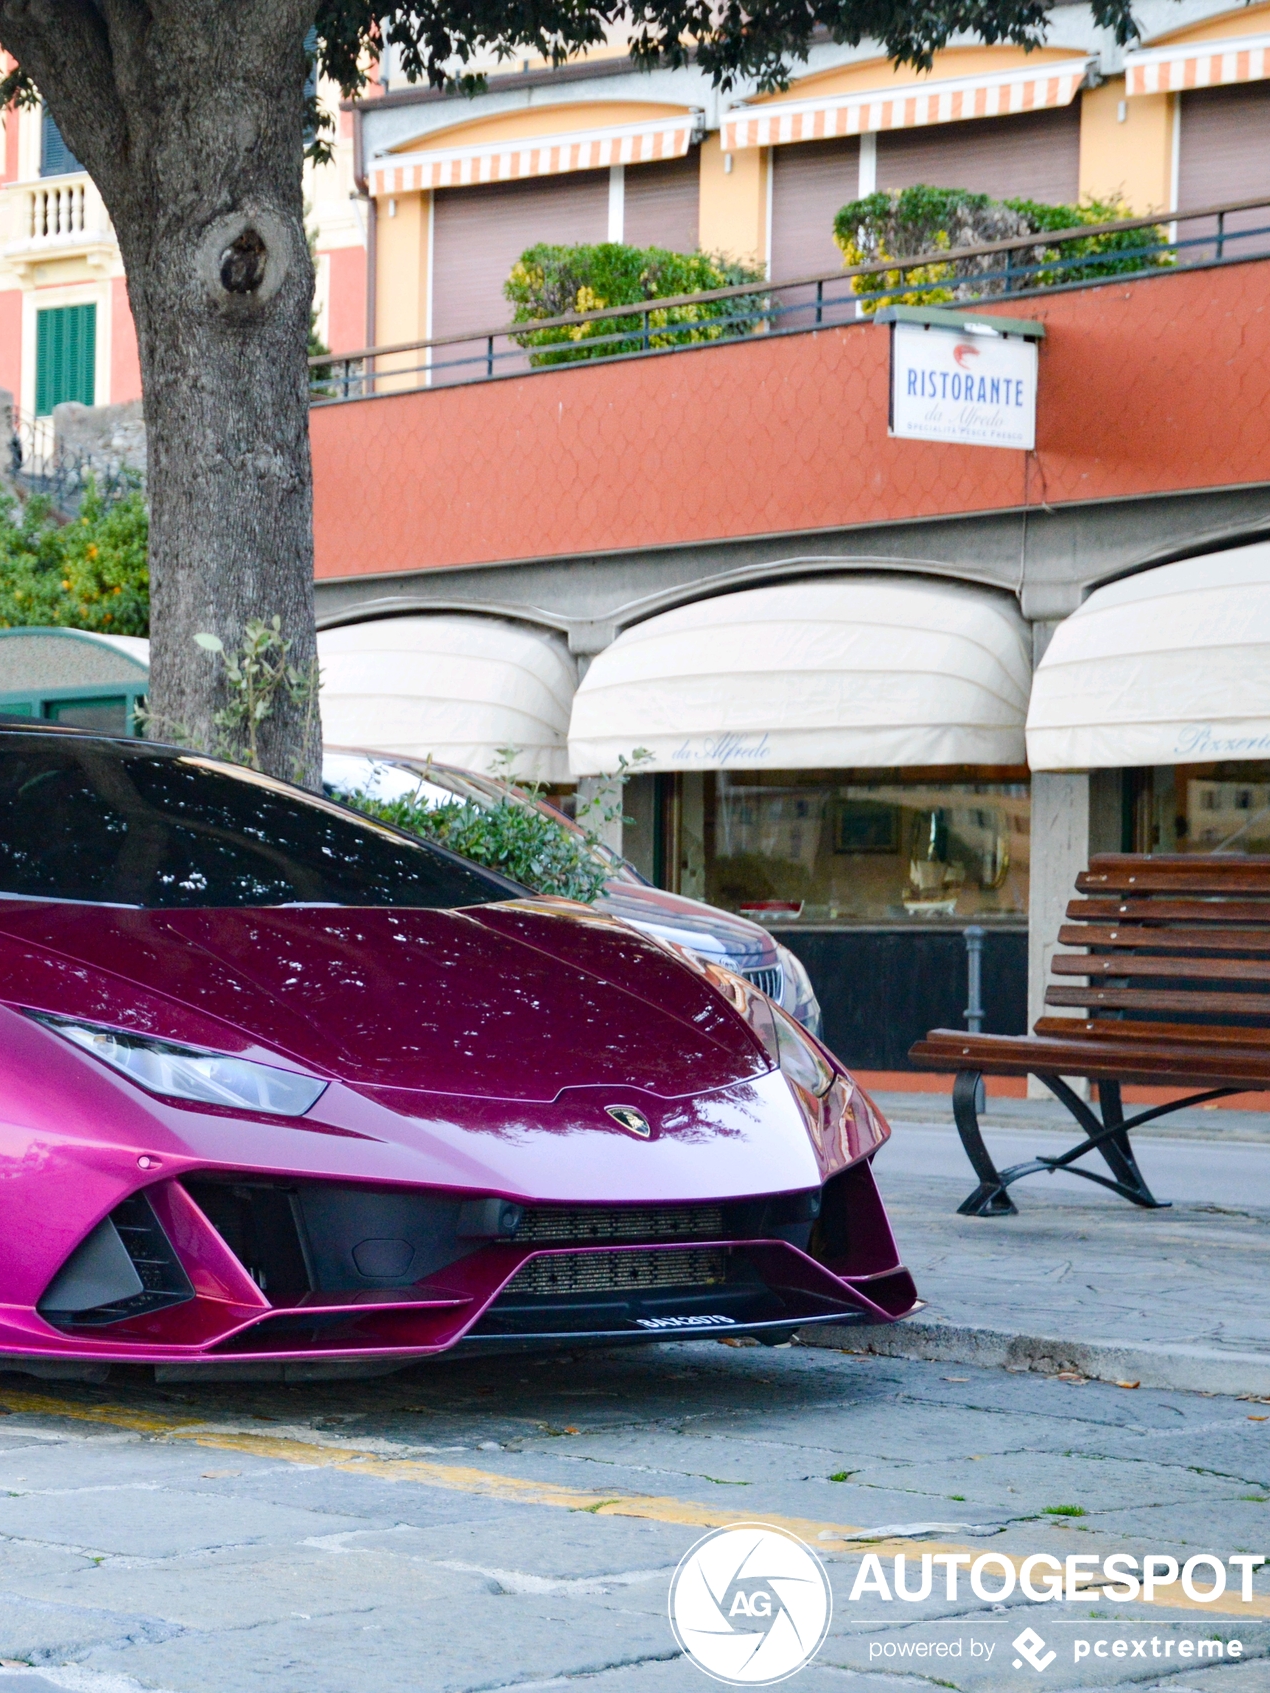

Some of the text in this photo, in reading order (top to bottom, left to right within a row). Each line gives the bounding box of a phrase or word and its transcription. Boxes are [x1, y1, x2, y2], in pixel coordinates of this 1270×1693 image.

[907, 368, 1023, 406] RISTORANTE
[924, 402, 1004, 427] da Alfredo
[671, 731, 772, 765] da Alfredo
